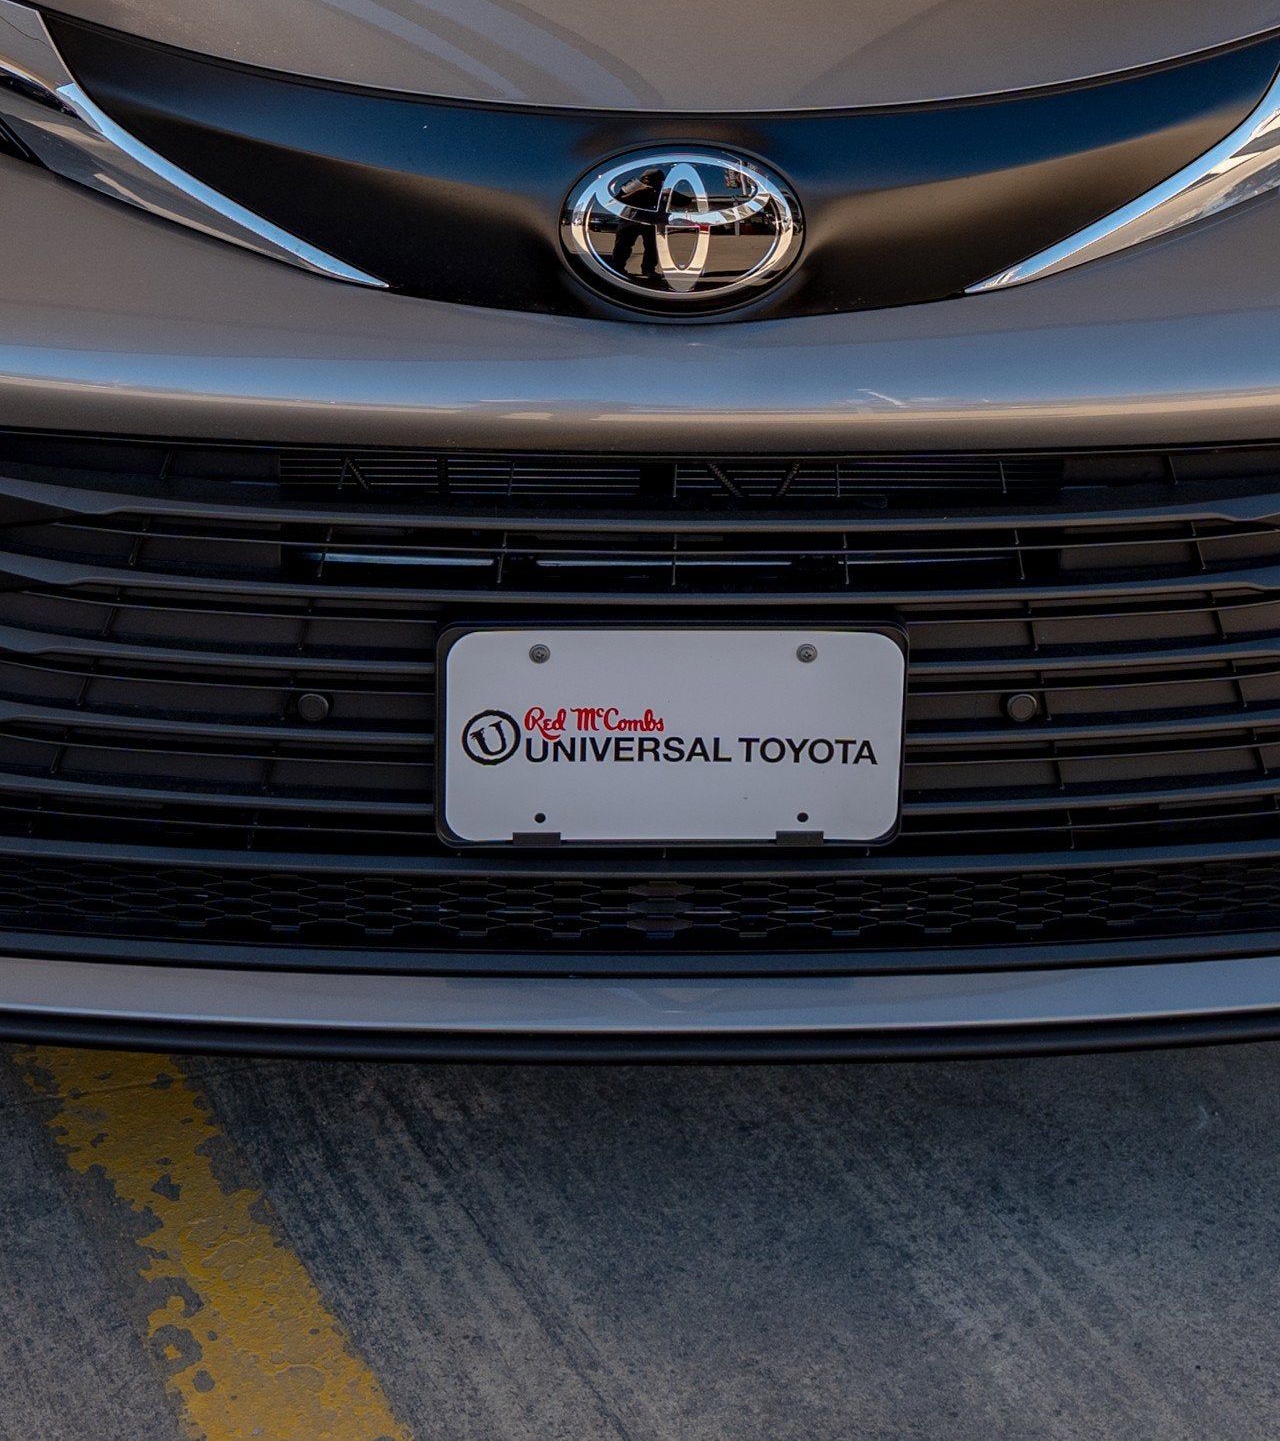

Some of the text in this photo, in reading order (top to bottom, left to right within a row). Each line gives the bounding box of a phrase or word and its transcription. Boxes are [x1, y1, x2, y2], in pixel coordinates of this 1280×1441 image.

[524, 706, 665, 741] Red McCombs
[524, 736, 879, 766] UNIVERSAL TOYOTA
